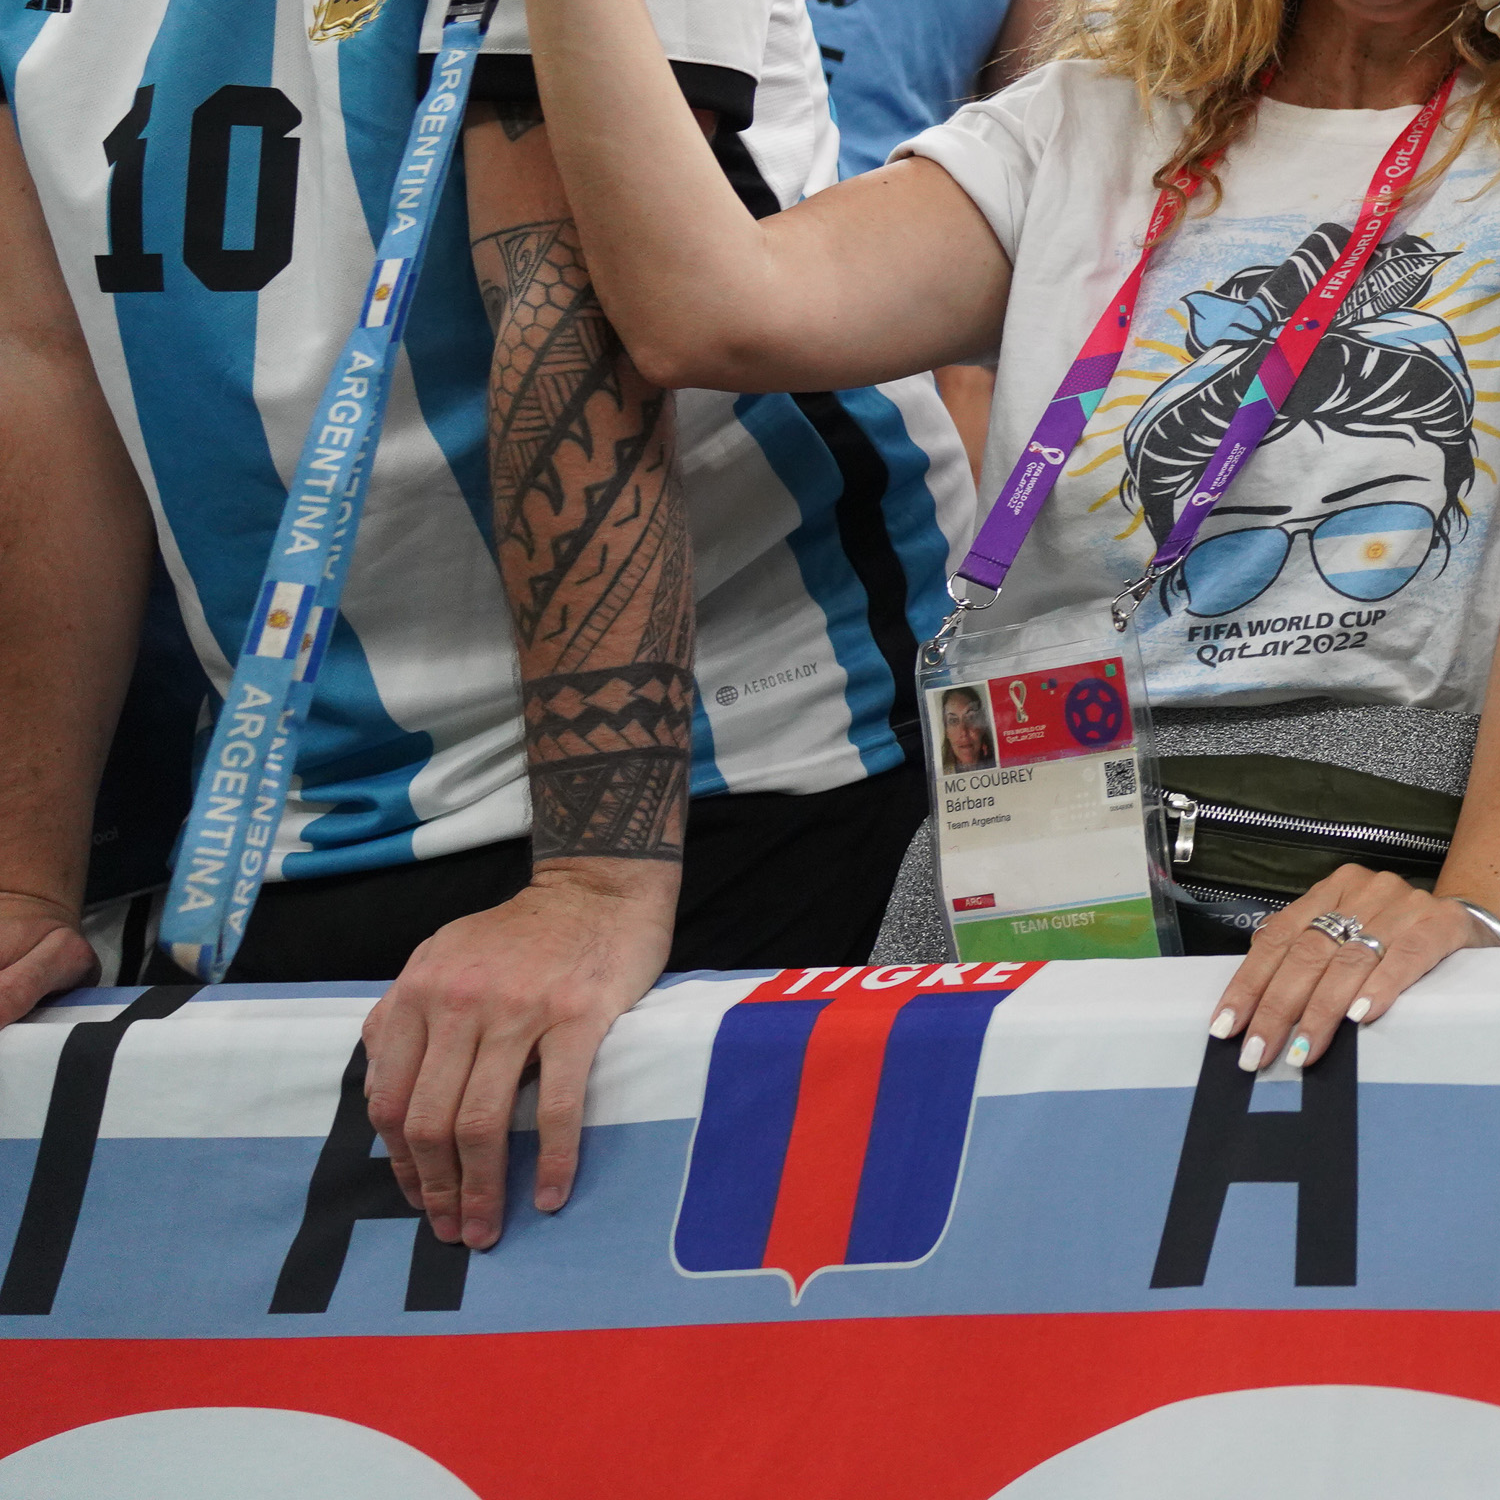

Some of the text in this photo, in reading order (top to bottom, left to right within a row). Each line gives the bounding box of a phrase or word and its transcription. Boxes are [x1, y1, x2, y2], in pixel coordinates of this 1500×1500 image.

[391, 49, 467, 236] ARGENTINA
[94, 83, 303, 293] 10
[1319, 264, 1348, 300] FIFA
[1344, 218, 1382, 268] WORLD
[284, 350, 376, 556] ARGENTINA
[1033, 461, 1046, 478] FIFA
[1022, 477, 1038, 501] WORLD
[1187, 609, 1387, 642] FIFA WORLD CUP
[1196, 631, 1369, 668] Qatar2022
[743, 662, 818, 696] AEROREADY
[944, 767, 1034, 794] MC COUBREY
[177, 683, 273, 914] ARGENTINA
[946, 796, 995, 813] Bárbara
[947, 813, 1012, 830] Team Argentina
[1010, 911, 1096, 935] TEAM GUEST
[782, 961, 1027, 996] TIGRE
